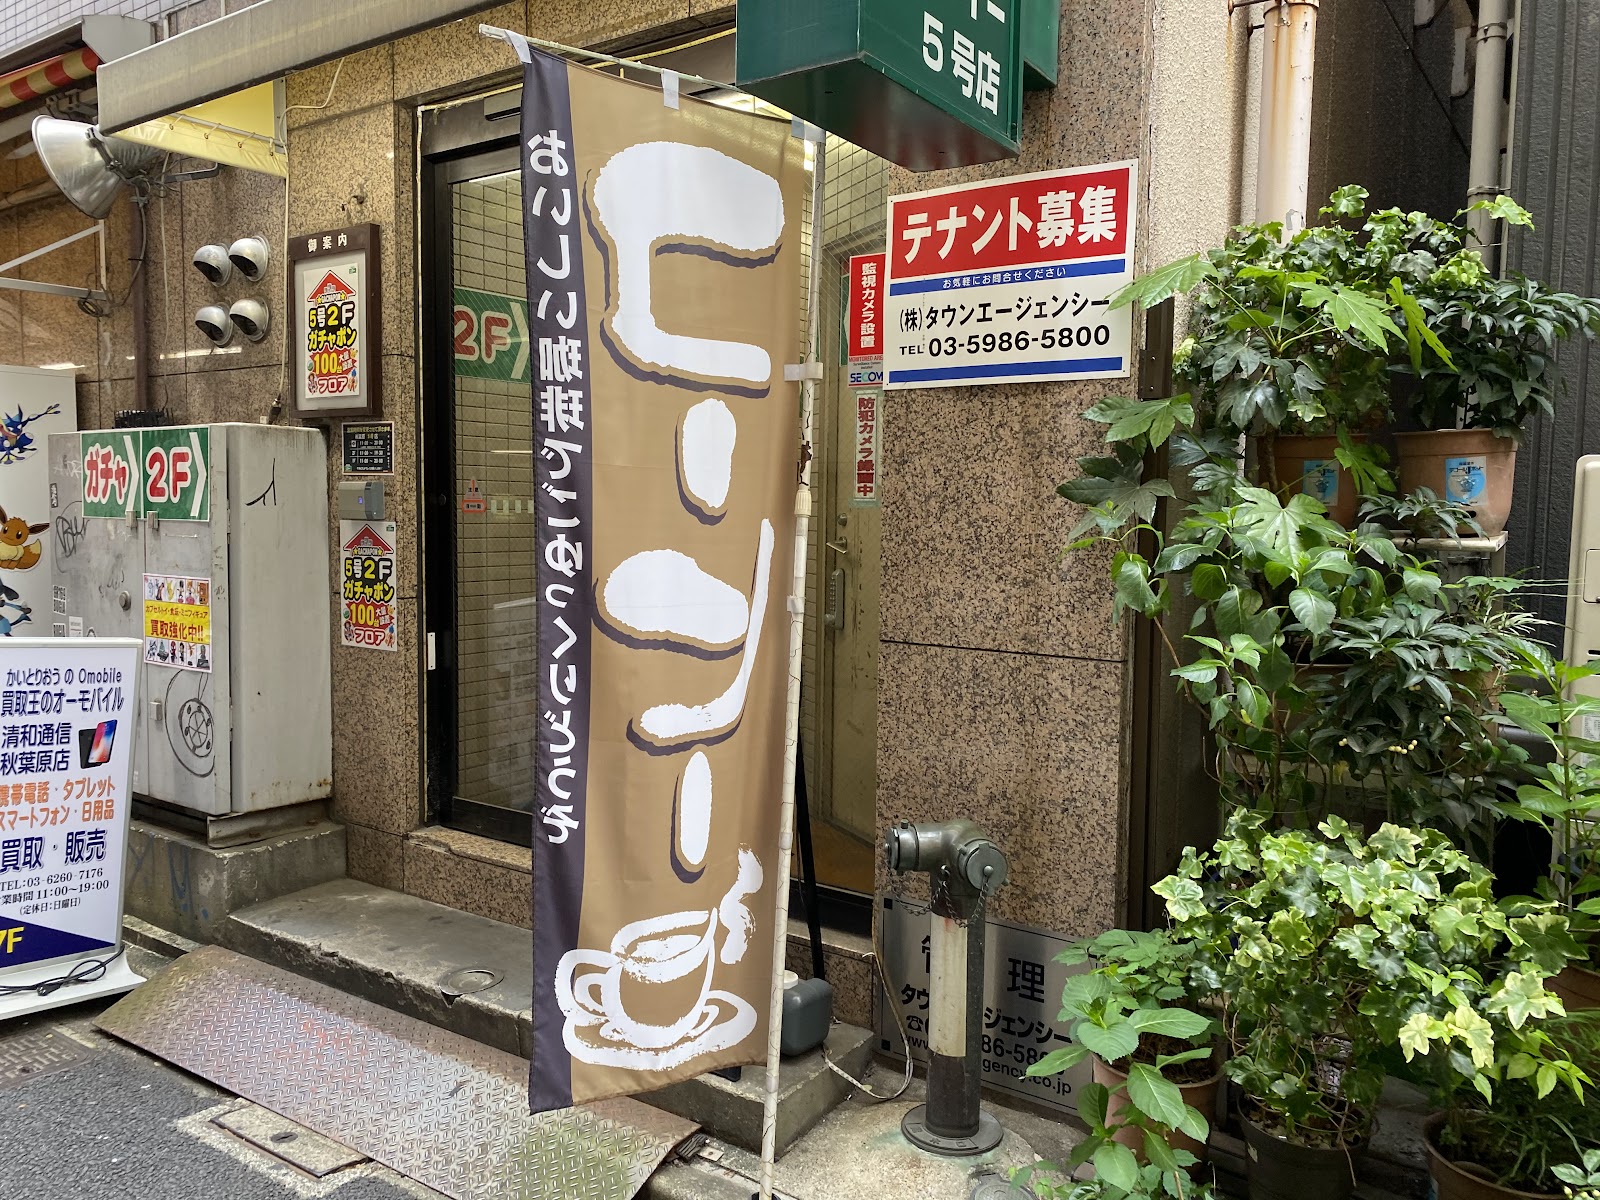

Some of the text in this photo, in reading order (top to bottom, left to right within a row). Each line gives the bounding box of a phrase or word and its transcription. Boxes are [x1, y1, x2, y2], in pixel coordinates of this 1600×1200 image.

[922, 10, 1002, 116] 5号店
[902, 185, 1117, 264] テナント募集
[307, 233, 347, 252] 御案内
[943, 267, 1067, 289] お気軽にお問合せください
[860, 262, 877, 348] 監視カメラ設置
[900, 291, 1110, 333] (株)タウンエージェンシー
[308, 327, 357, 351] ガチャポン
[454, 306, 511, 362] 2F
[899, 325, 1110, 357] TEL 03-5986-5800
[318, 377, 348, 394] フロア
[857, 397, 875, 497] 防犯カメラ録画中
[86, 445, 128, 503] ガチャ
[147, 449, 190, 501] 2F
[344, 579, 393, 602] ガチャポン
[150, 619, 204, 642] 買取強化中!!
[354, 628, 386, 646] フロア
[6, 667, 122, 687] かいとりおう の Omobile
[1, 687, 125, 717] 買取王のオーモバイル
[1, 722, 72, 749] 清和通信
[0, 748, 71, 776] 秋葉原店
[0, 890, 34, 906] 業時間
